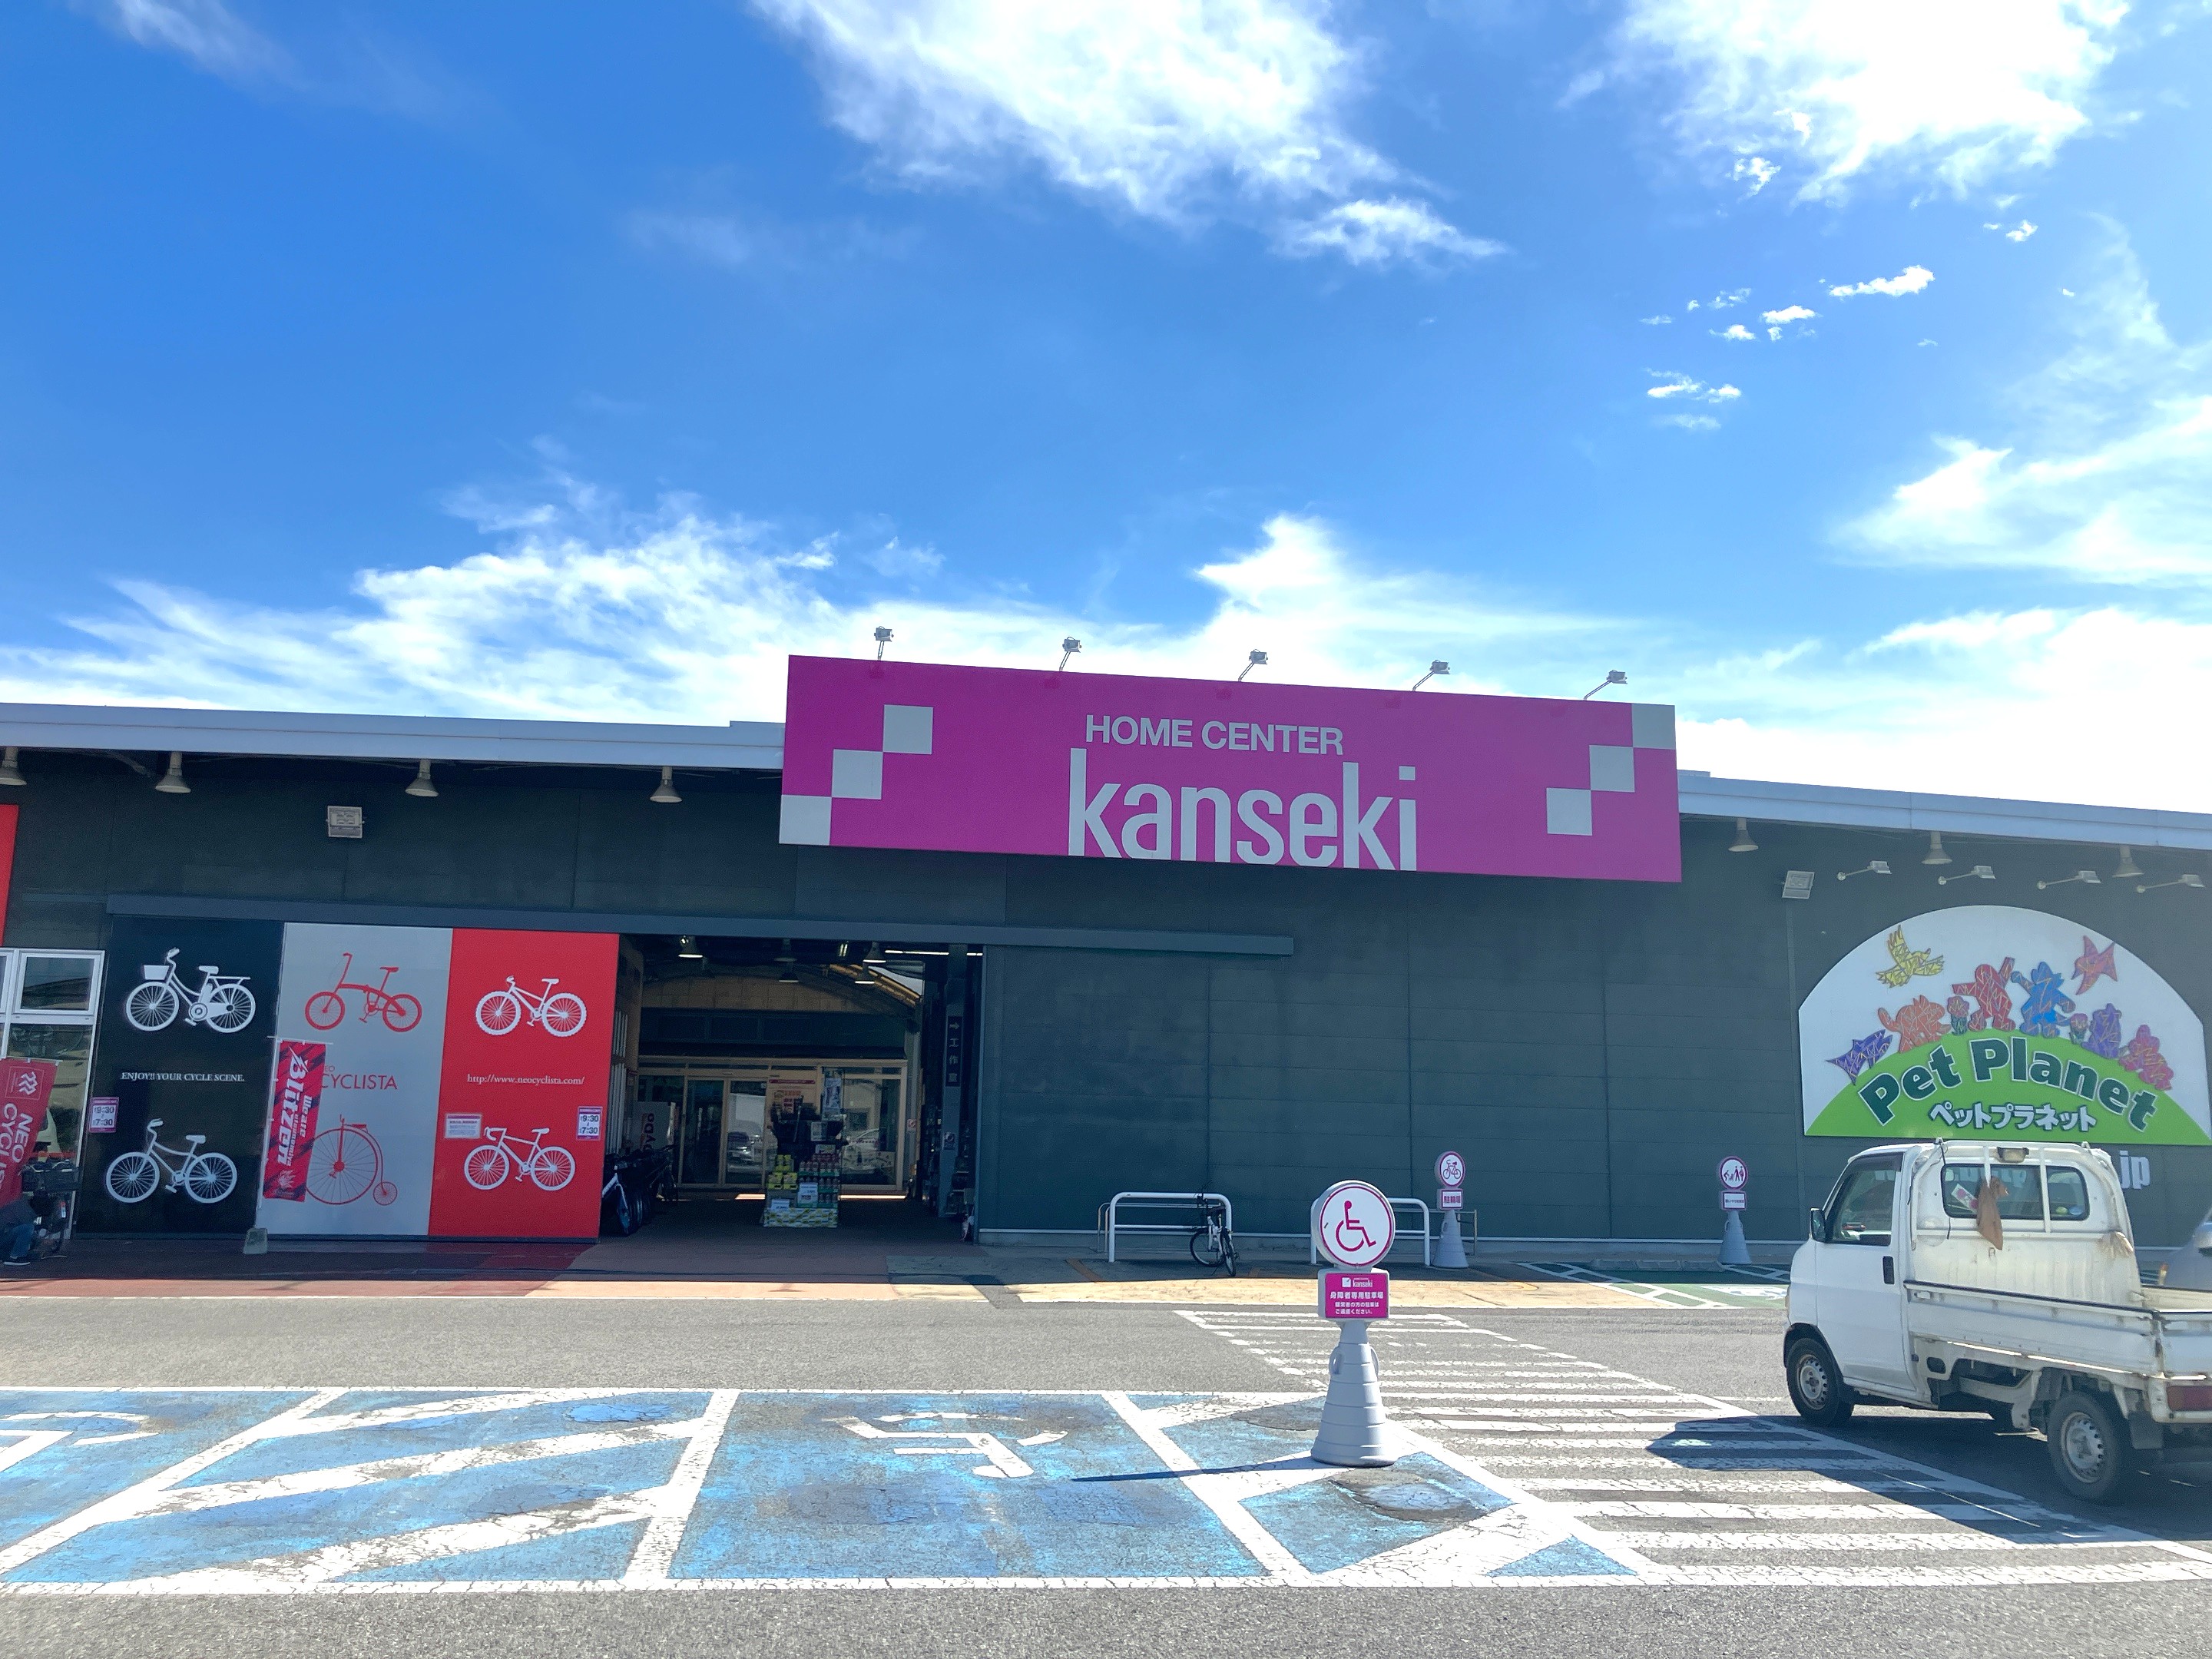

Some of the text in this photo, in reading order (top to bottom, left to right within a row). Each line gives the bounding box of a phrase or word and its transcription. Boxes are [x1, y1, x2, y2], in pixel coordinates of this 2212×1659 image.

[1085, 714, 1343, 756] HOME CENTER
[1068, 747, 1417, 871] kanseki
[156, 1073, 183, 1081] YOUR
[184, 1073, 213, 1082] CYCLE
[466, 1074, 585, 1087] http://www.neocyclista.com/
[1856, 1035, 2158, 1133] Pet Planet
[12, 1112, 33, 1164] NEO
[1929, 1101, 2098, 1133] ペットプラネット
